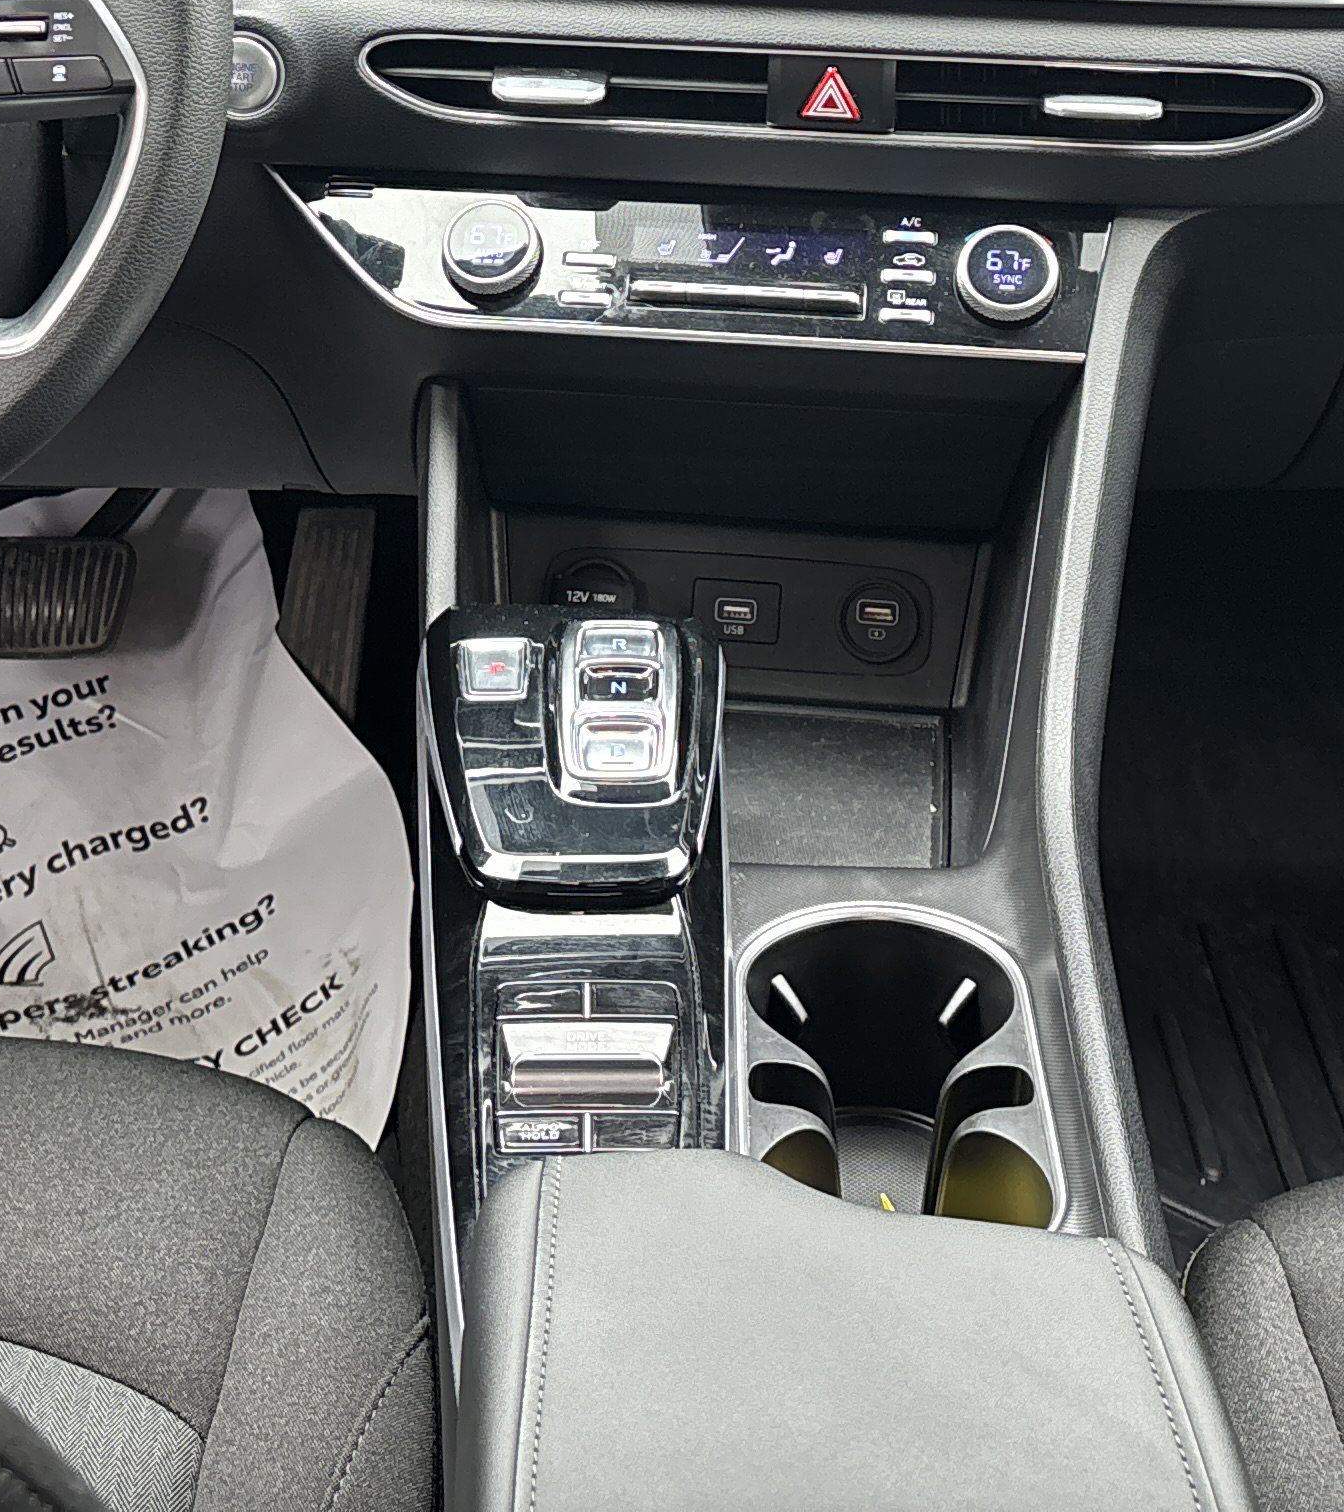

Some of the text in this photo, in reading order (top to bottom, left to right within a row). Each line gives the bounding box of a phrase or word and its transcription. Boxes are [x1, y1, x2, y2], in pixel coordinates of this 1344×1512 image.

[900, 217, 923, 227] A/C
[992, 274, 1023, 285] SYNC
[905, 297, 927, 307] REAR
[566, 590, 617, 604] 12V 180W
[723, 624, 745, 635] USB
[612, 638, 628, 651] R
[610, 681, 627, 694] N
[29, 672, 111, 722] your
[46, 794, 212, 876] charged?
[87, 893, 276, 1001] streaking?
[74, 947, 270, 1044] Manager can help
[119, 994, 233, 1045] and more.
[233, 971, 345, 1057] CHECK
[287, 1026, 320, 1056] floor
[565, 1030, 606, 1042] DRIVE
[565, 1041, 606, 1052] MODE
[298, 1071, 318, 1088] be
[519, 1130, 560, 1141] HOLD
